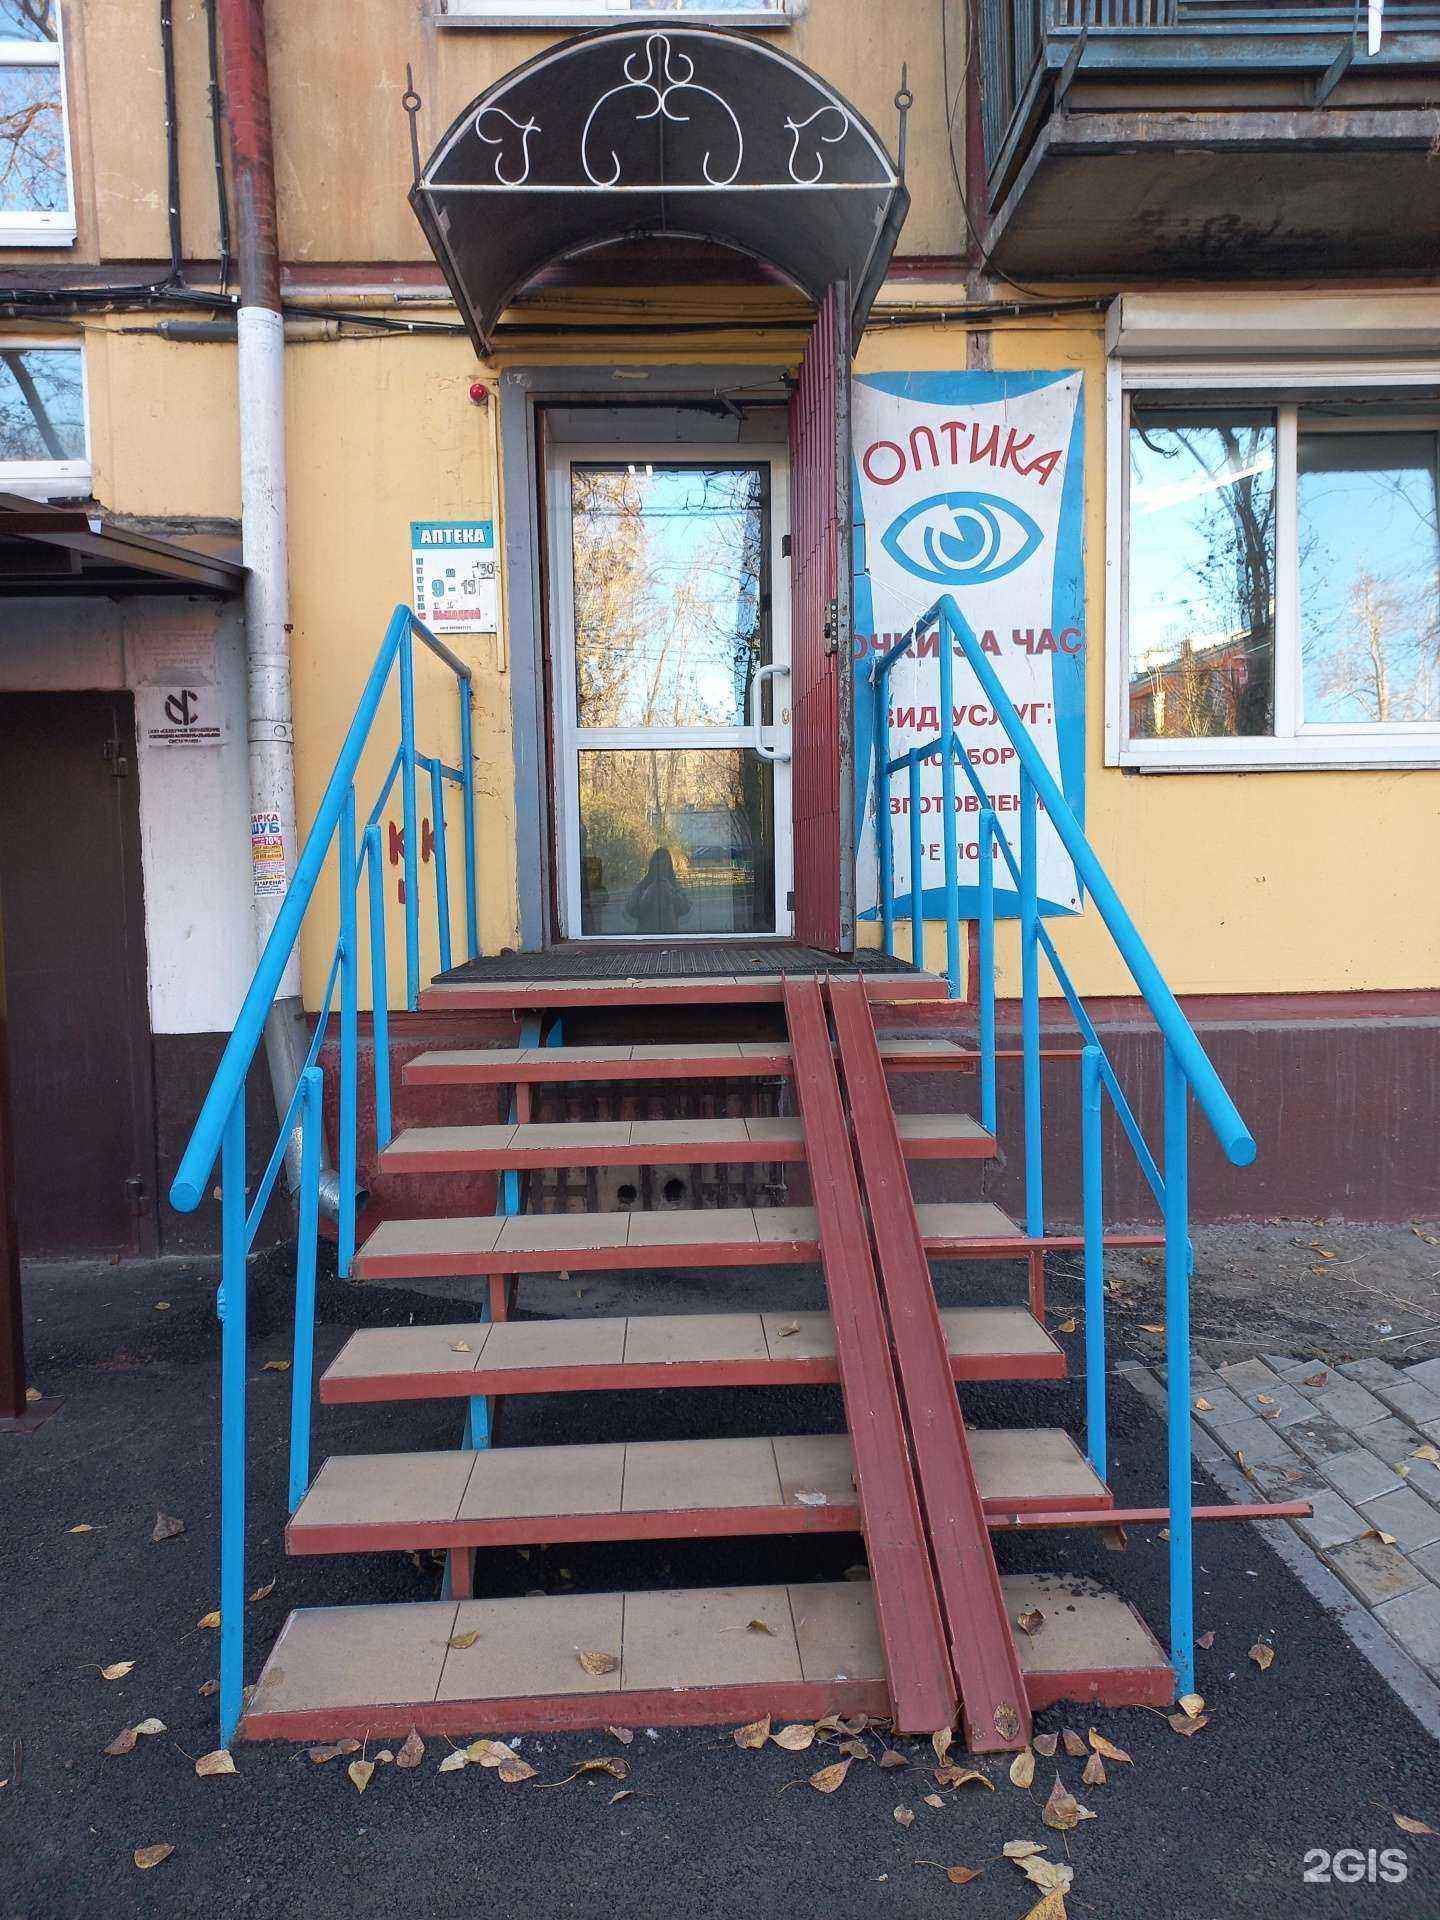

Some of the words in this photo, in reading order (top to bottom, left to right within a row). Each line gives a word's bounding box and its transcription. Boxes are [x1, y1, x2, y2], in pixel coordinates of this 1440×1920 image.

[863, 421, 1063, 486] ОПТИКА
[420, 528, 487, 545] АПТЕКА
[1012, 627, 1083, 656] ЧАС
